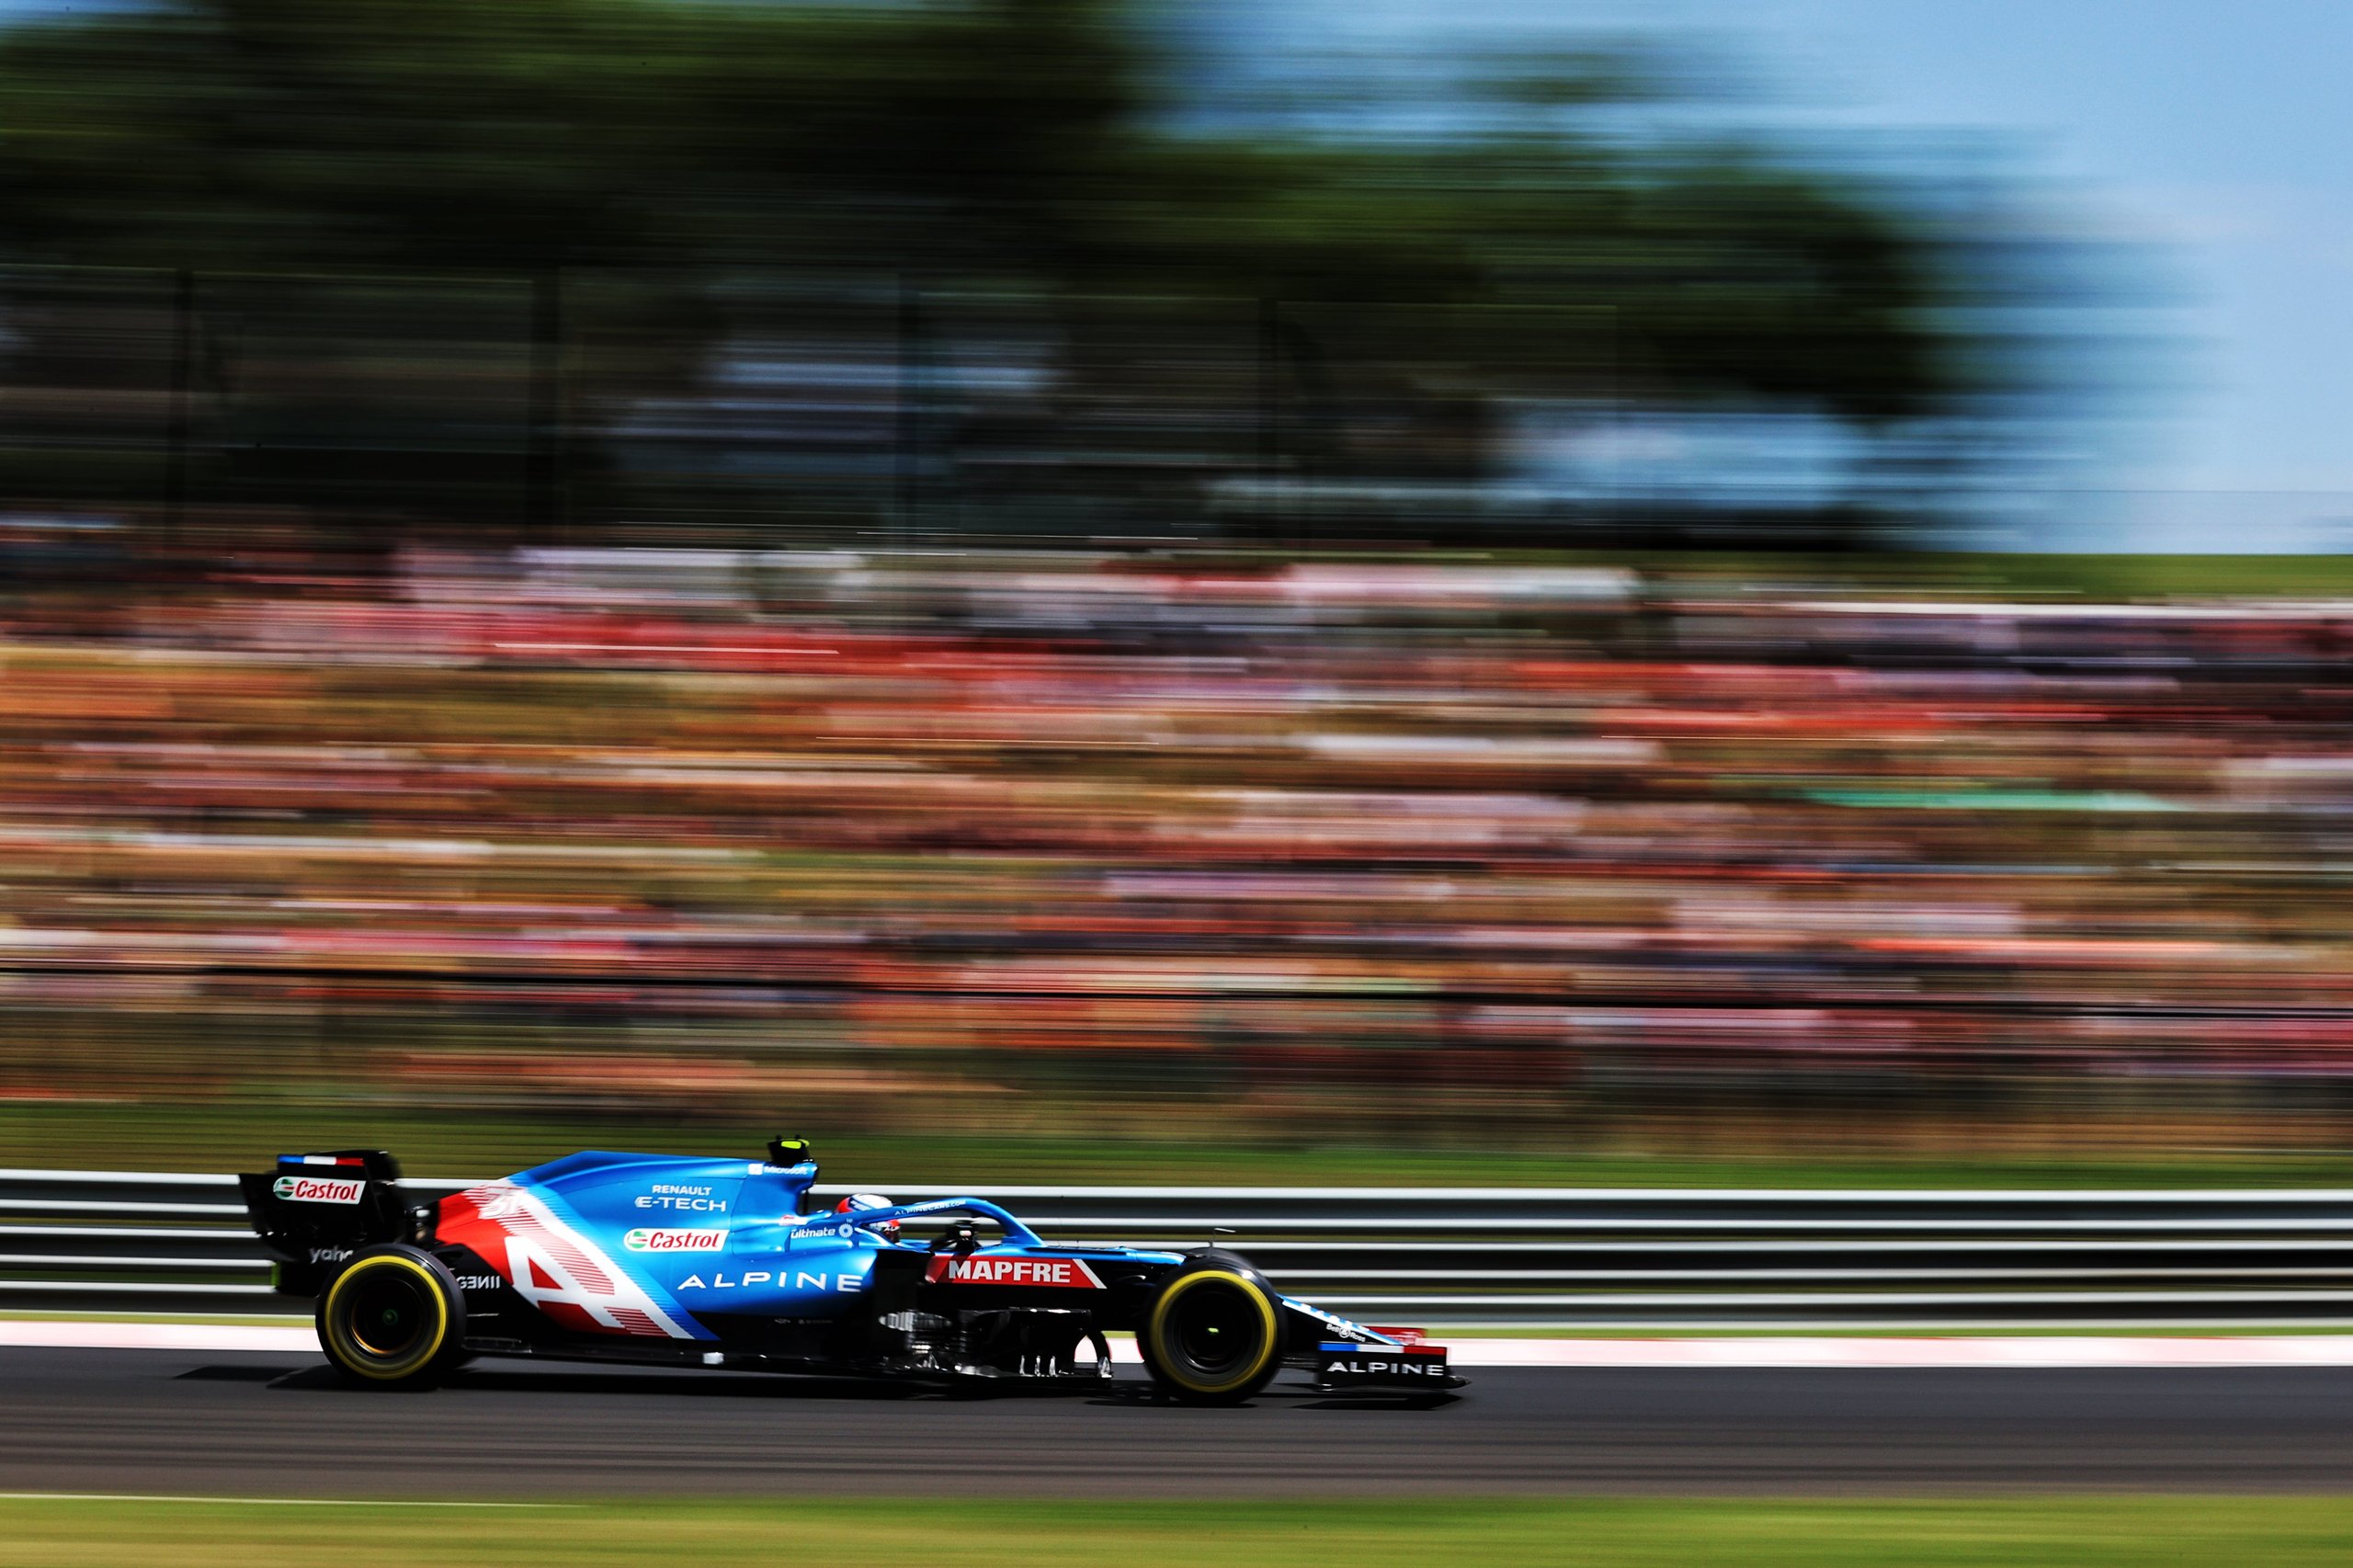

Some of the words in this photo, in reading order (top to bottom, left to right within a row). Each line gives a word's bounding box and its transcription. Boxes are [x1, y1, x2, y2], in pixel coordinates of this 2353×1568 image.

[295, 1179, 359, 1201] Castrol
[652, 1185, 712, 1196] RENAULT
[634, 1196, 726, 1212] E-TECH
[649, 1231, 720, 1249] Castrol
[949, 1260, 1071, 1283] MAPFRE
[676, 1271, 864, 1293] ALPINE
[1325, 1361, 1445, 1376] ALPINE
